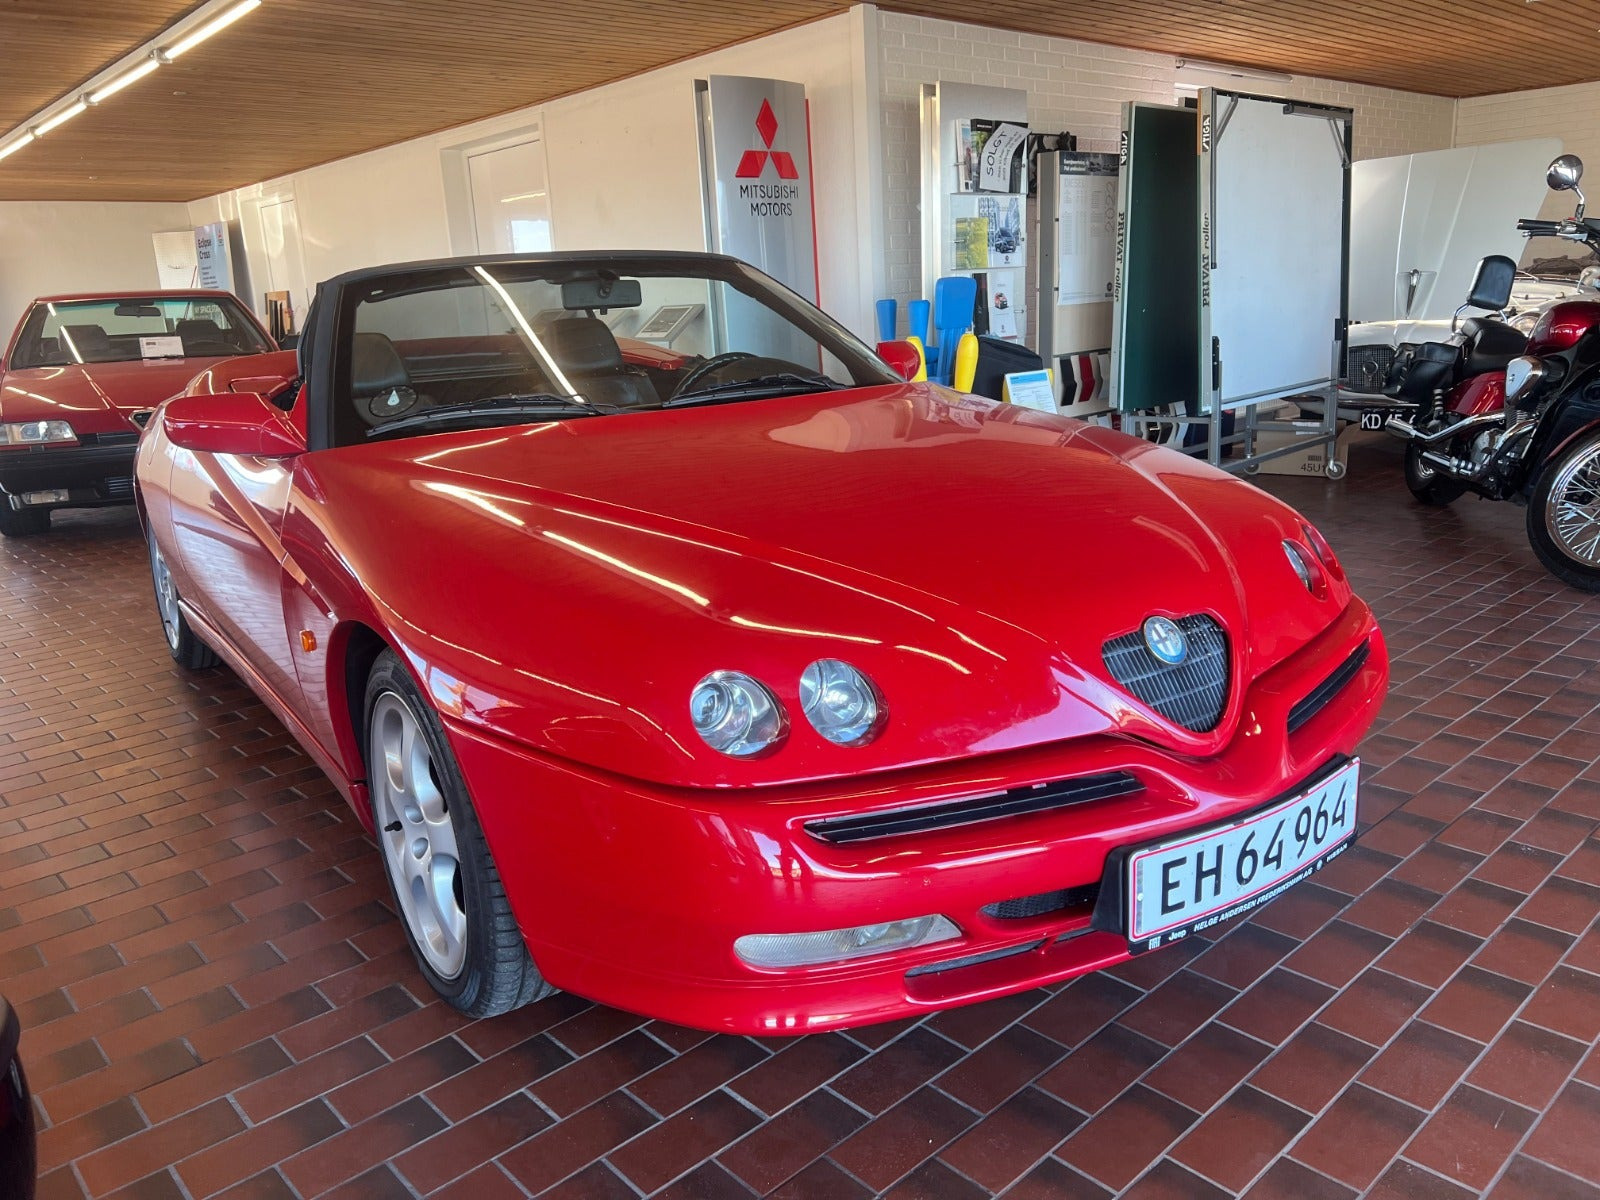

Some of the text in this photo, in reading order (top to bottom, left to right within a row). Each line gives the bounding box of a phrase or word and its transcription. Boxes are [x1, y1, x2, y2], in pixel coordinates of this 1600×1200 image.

[986, 131, 1007, 176] SOLGT
[740, 184, 799, 199] MITSUBISHI
[750, 202, 793, 217] MOTORS
[197, 238, 212, 249] Eclipse
[199, 250, 211, 260] Cross
[1114, 212, 1125, 302] PRIVAT roller
[1202, 213, 1210, 308] PRIVAT roller
[1361, 413, 1381, 429] KD
[1160, 780, 1347, 915] EH 64 964
[1148, 936, 1161, 950] FIAT
[1168, 930, 1187, 941] Jeep
[1193, 915, 1219, 932] HELGE
[1219, 899, 1257, 921] ANDERSEN
